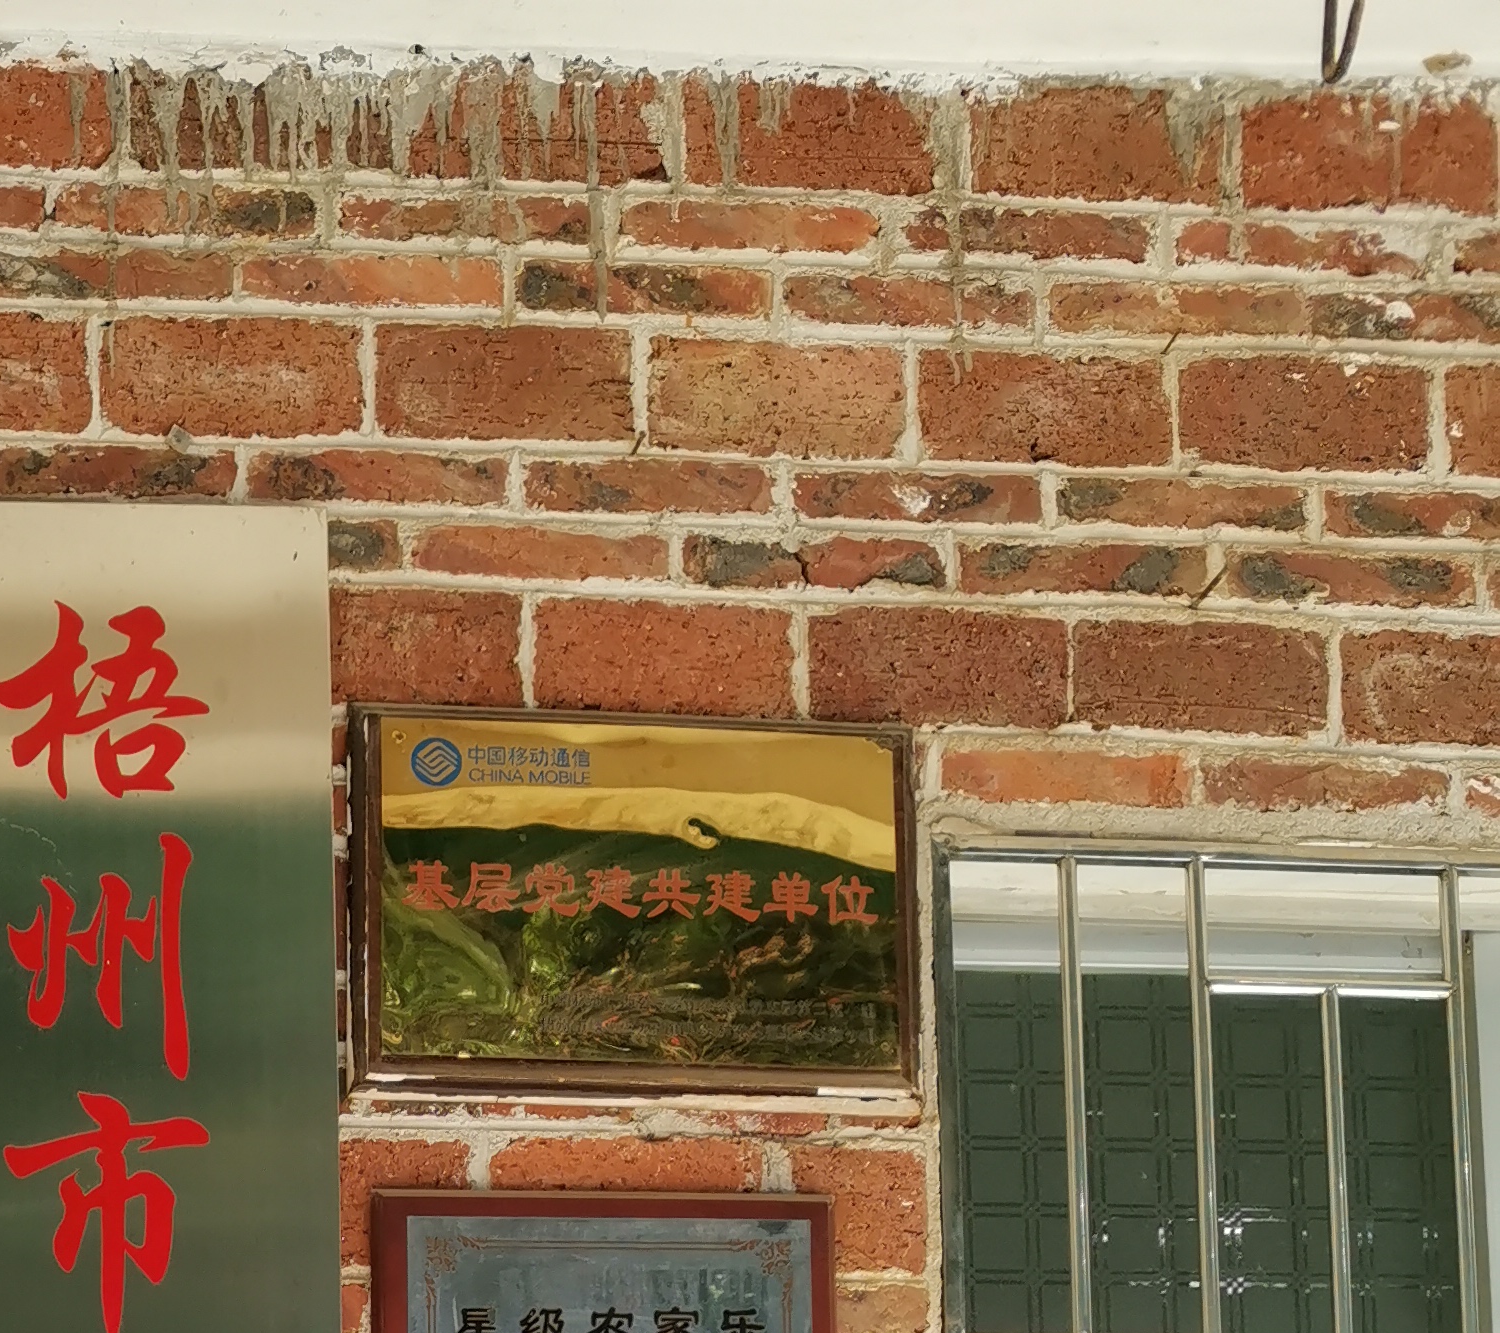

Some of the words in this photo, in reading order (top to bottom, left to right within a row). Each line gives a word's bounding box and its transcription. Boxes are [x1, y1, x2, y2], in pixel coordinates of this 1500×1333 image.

[467, 745, 591, 769] 中国移动通信
[468, 767, 525, 785] CHINA
[528, 769, 592, 786] MOBILE
[403, 859, 879, 926] 基层党建共建单位
